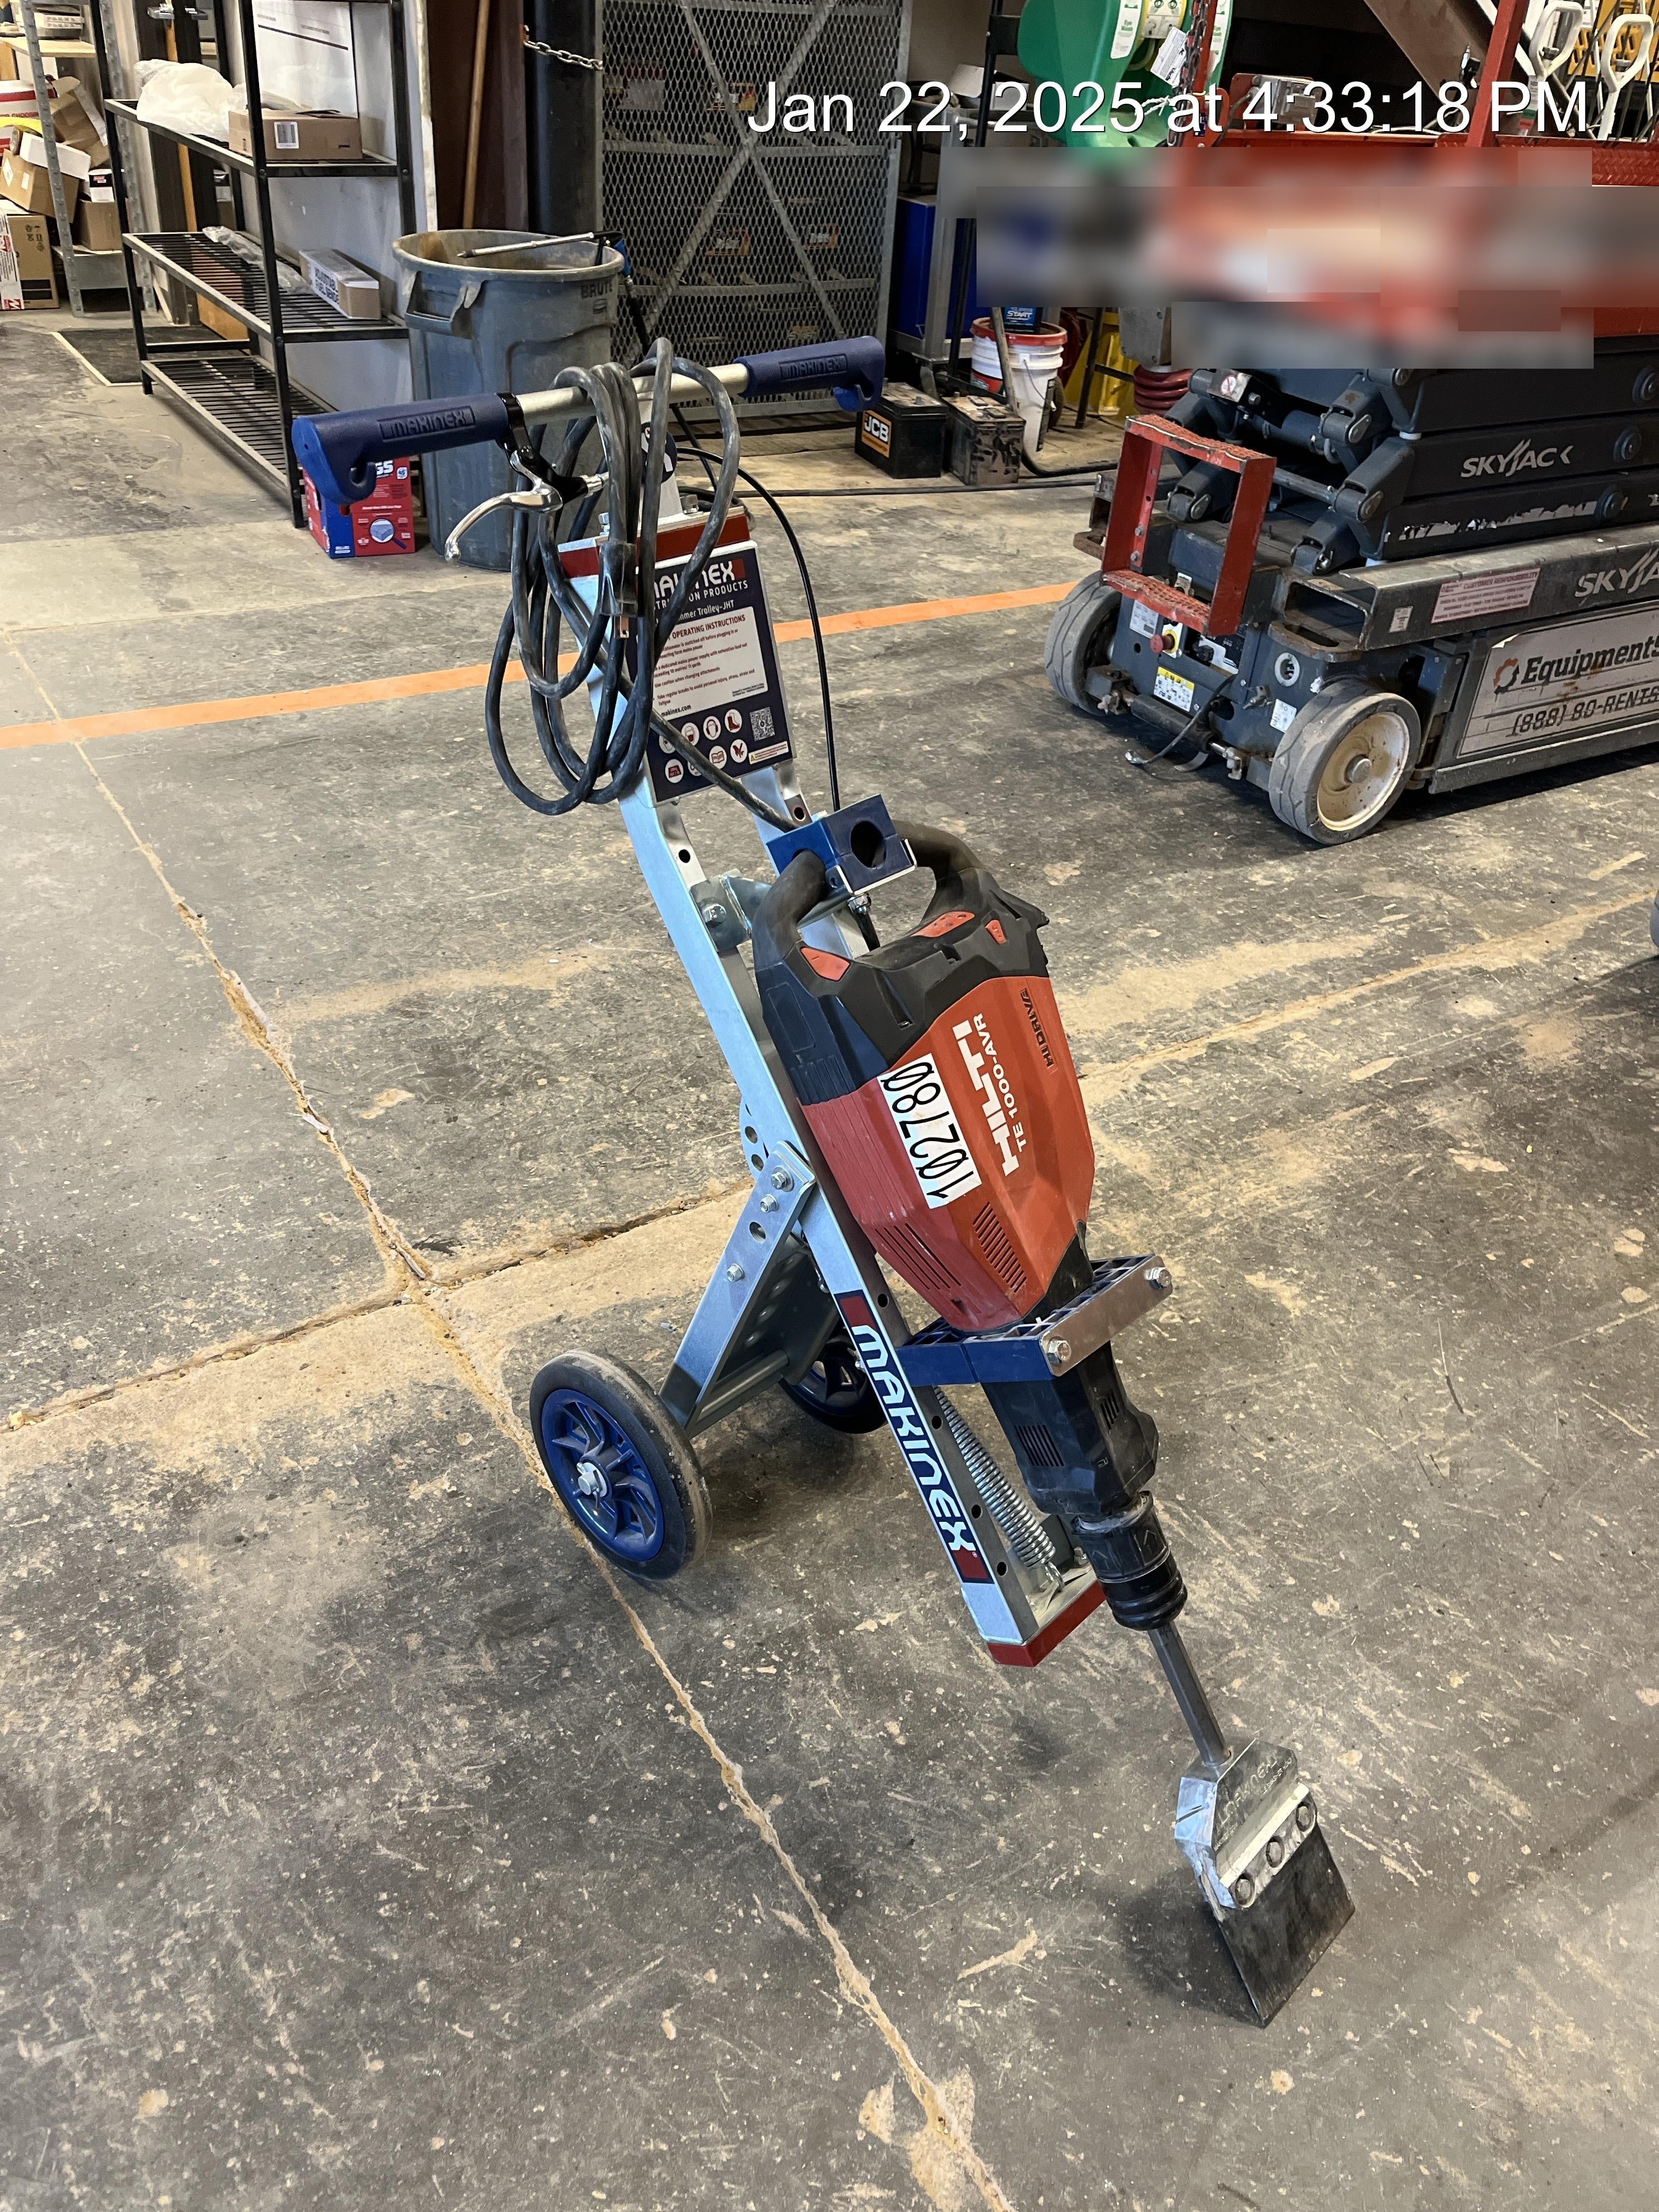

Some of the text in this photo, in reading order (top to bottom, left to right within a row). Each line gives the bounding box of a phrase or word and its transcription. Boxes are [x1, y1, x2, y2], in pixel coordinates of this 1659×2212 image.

[390, 410, 467, 437] MAKINEX
[864, 416, 889, 442] JCB
[1460, 439, 1575, 478] SKYJACK
[703, 580, 748, 599] PRODUCTS
[697, 600, 735, 616] Trolley-JHT
[672, 625, 705, 639] OPERATING
[706, 614, 746, 631] INSTRUCTIONS
[661, 704, 692, 717] makinex.com
[1511, 704, 1567, 736] (888)
[973, 1013, 1027, 1153] TE 1000-AVR
[952, 1019, 1020, 1177] HILTI
[851, 1325, 976, 1553] MAKINEX
